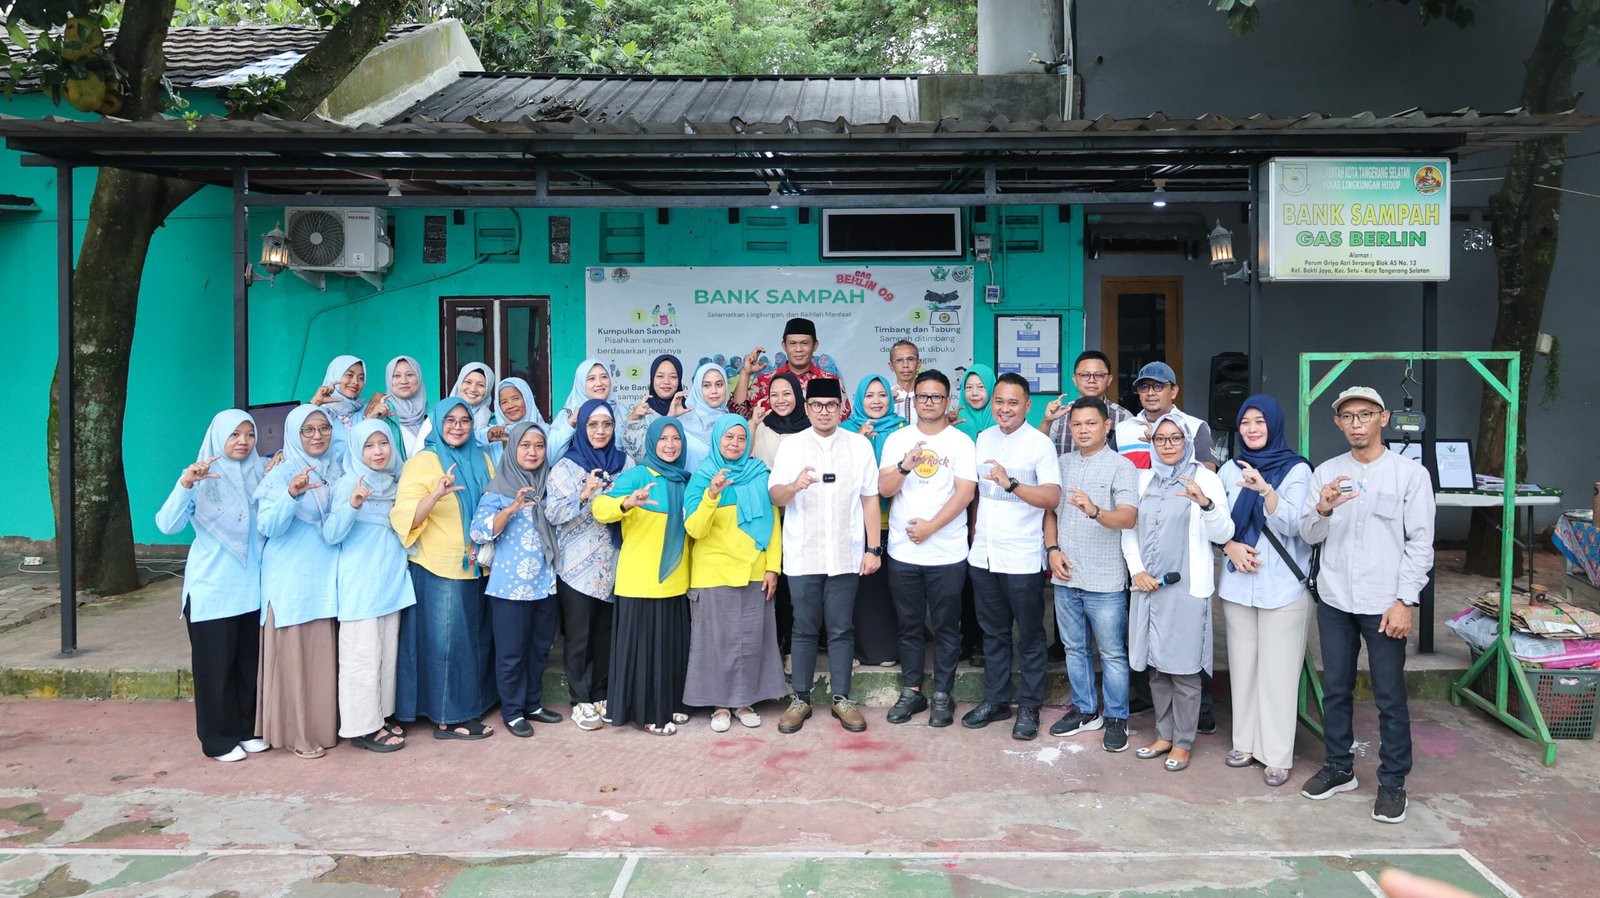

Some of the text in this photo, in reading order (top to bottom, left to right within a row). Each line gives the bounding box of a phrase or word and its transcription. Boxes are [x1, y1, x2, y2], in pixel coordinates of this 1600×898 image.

[1345, 167, 1358, 179] KOTA
[1359, 167, 1388, 179] TANGERANG
[1389, 167, 1411, 179] SELATAN
[1342, 181, 1381, 190] LINGKUNGAN
[1382, 181, 1401, 190] HIDUP
[1283, 203, 1440, 226] BANK SAMPAH
[1296, 231, 1427, 247] GAS BERLIN
[1323, 259, 1339, 267] Griya
[1352, 259, 1375, 267] Serpong
[855, 270, 872, 280] GAS
[1378, 267, 1408, 275] Tangerang
[836, 273, 894, 302] BERLIN 09
[694, 289, 865, 304] BANK SAMPAH
[636, 312, 641, 320] 1
[746, 311, 784, 319] Lingkungan,
[914, 311, 921, 320] 3
[597, 327, 681, 337] Kumpulkan Sampah
[874, 325, 961, 334] Timbang dan Tabung
[604, 336, 674, 346] Pisahkan sampah
[914, 335, 955, 344] ditimbang
[597, 347, 682, 356] berdasarkan jenisnya
[631, 369, 638, 377] 2
[617, 394, 647, 402] sampa
[927, 455, 950, 468] Rock
